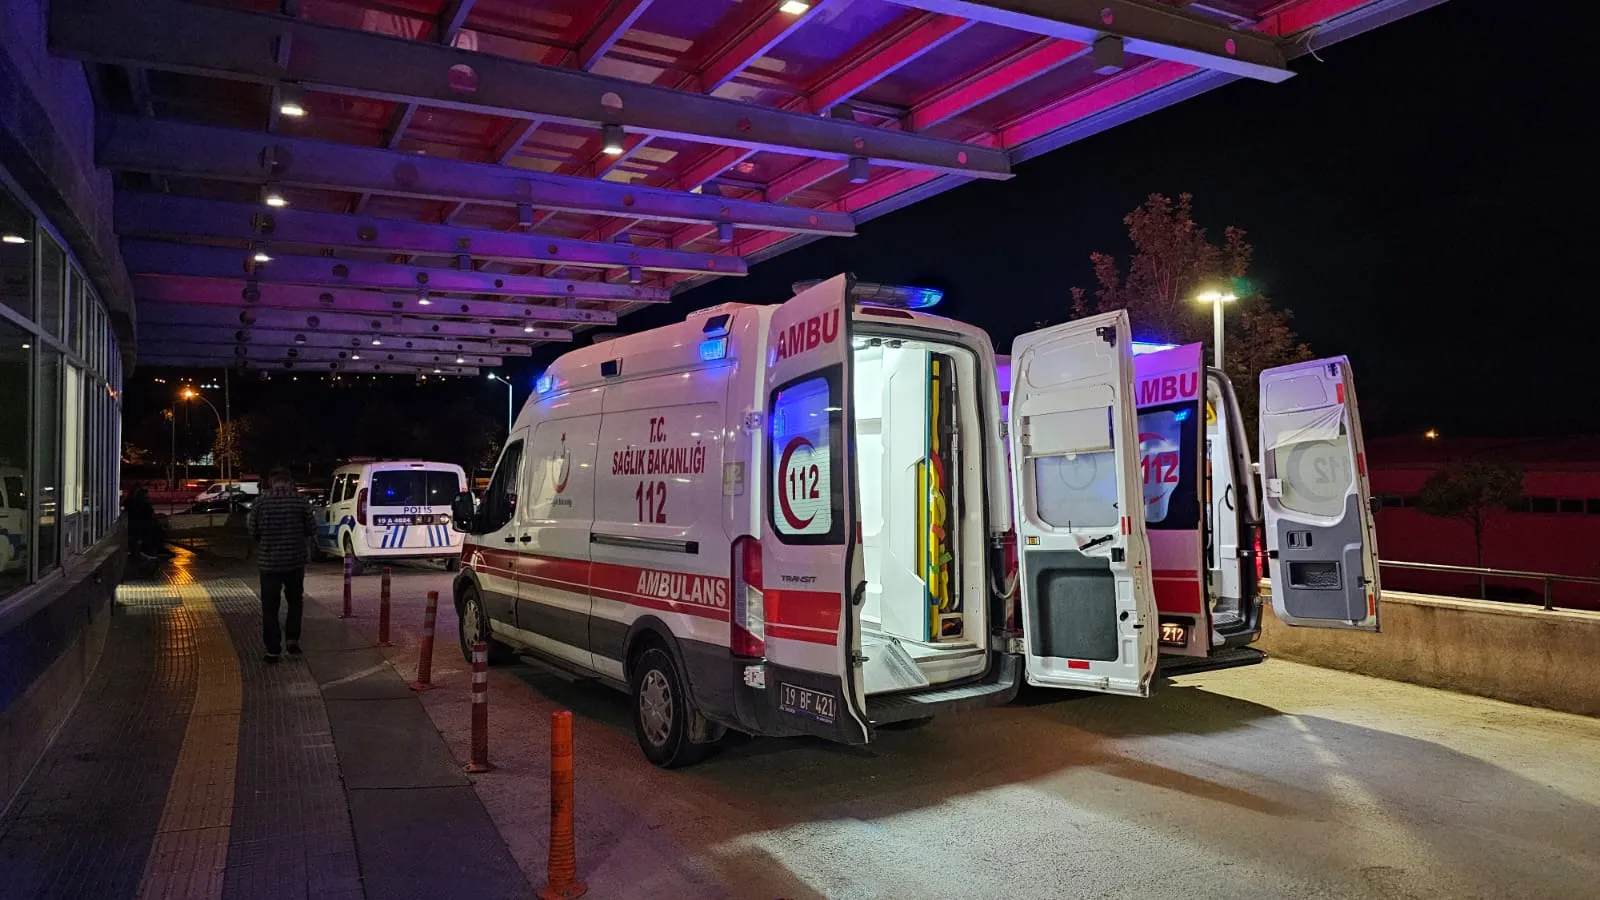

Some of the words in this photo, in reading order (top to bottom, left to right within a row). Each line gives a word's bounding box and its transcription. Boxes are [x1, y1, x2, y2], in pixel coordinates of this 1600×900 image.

[776, 308, 840, 362] AMBU
[1135, 372, 1198, 405] MBU
[651, 416, 667, 443] T.C.
[612, 446, 645, 476] SAĞLIK
[1140, 453, 1179, 484] 112
[790, 464, 820, 501] 112
[636, 481, 667, 524] 112
[637, 570, 727, 608] AMBULANS
[780, 575, 817, 583] TRANSIT
[785, 687, 796, 706] 19
[801, 690, 812, 710] BF
[815, 695, 834, 717] 421
